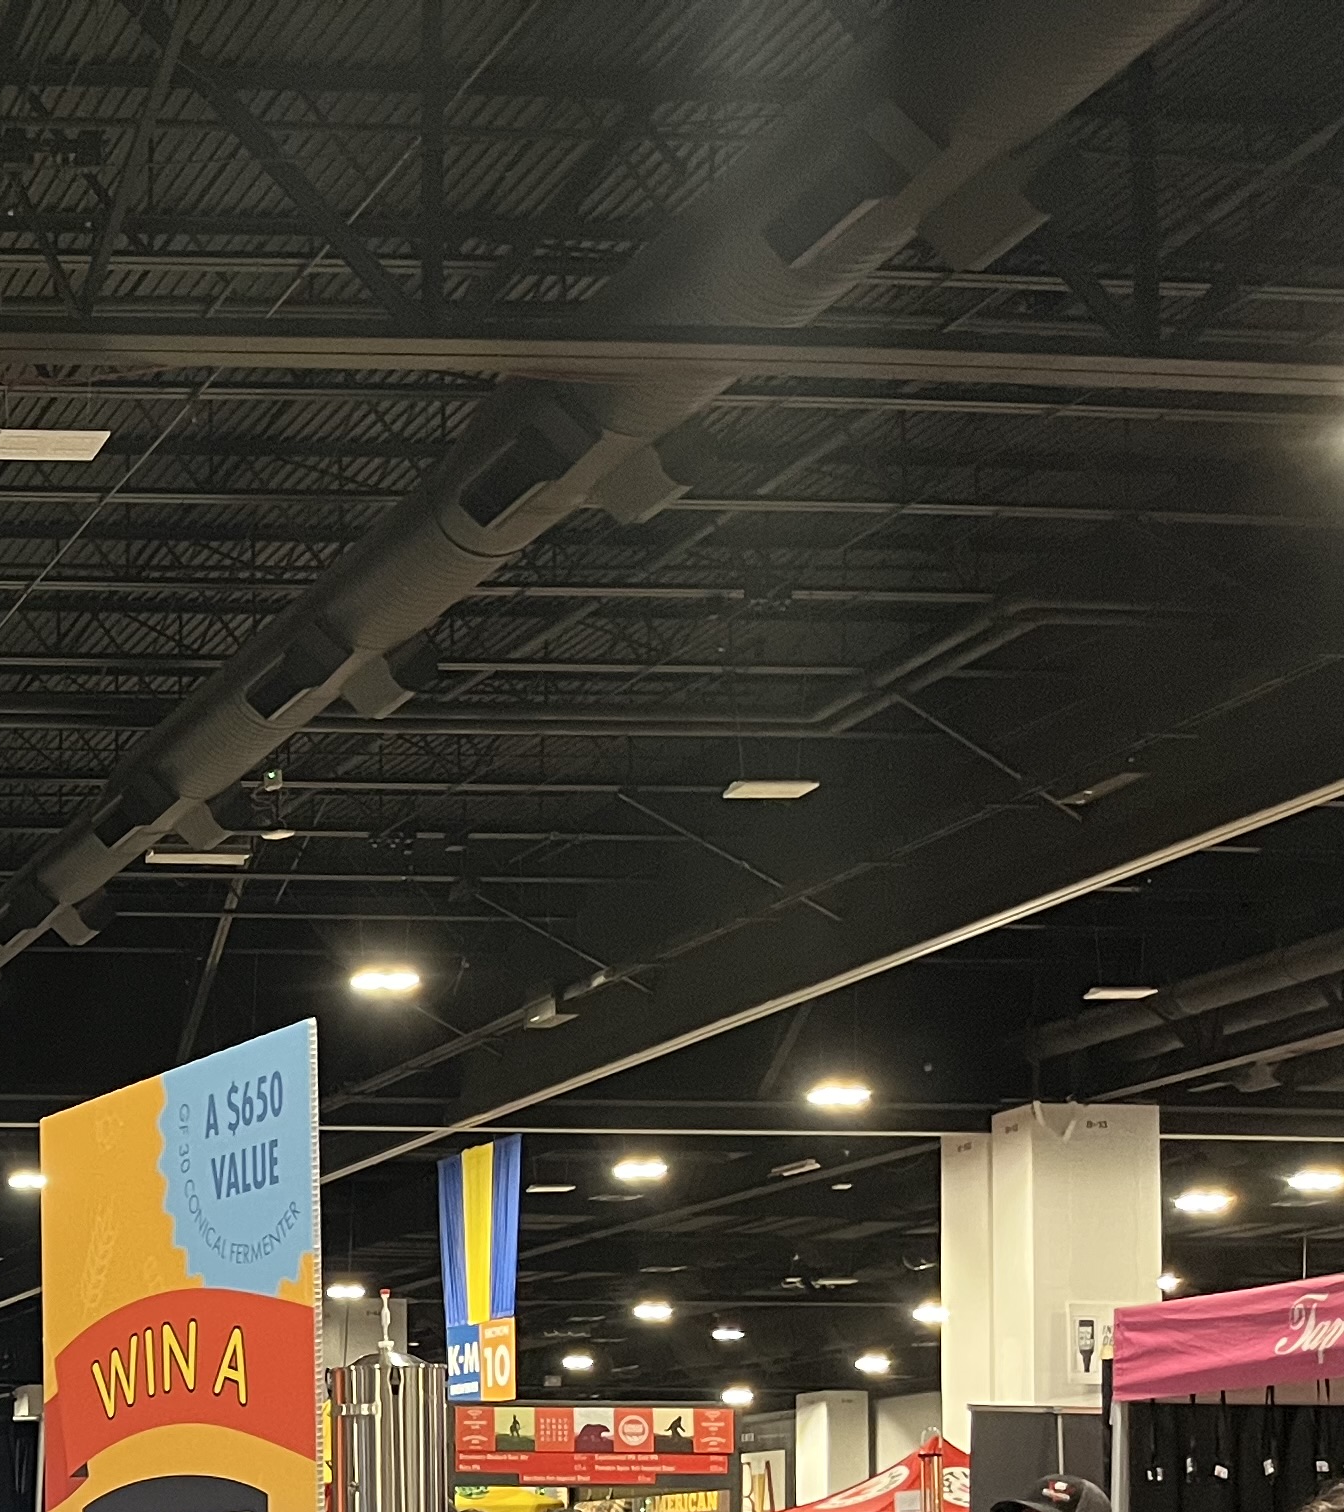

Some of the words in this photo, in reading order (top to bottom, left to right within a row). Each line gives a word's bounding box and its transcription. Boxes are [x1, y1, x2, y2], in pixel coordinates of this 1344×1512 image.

[205, 1093, 219, 1139] A
[227, 1070, 283, 1136] $650
[211, 1138, 279, 1200] VALUE
[184, 1179, 227, 1260] CONICAL
[230, 1201, 301, 1264] FERMENTER
[91, 1318, 198, 1419] WIN
[212, 1325, 248, 1406] A
[484, 1344, 511, 1388] 10
